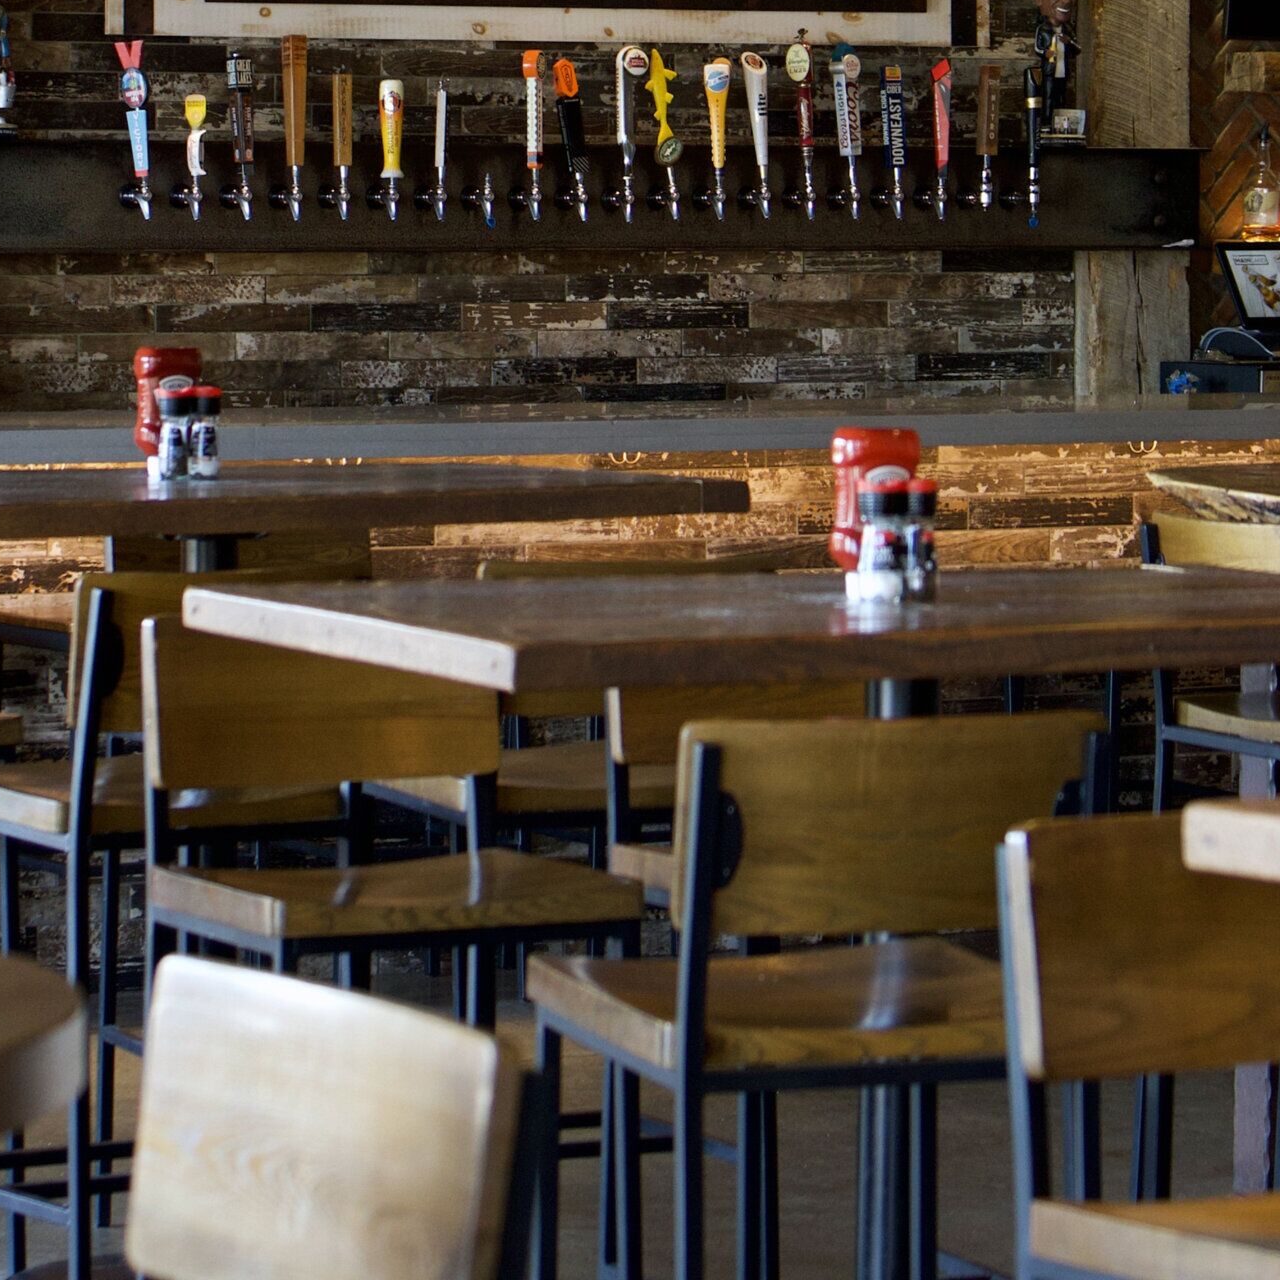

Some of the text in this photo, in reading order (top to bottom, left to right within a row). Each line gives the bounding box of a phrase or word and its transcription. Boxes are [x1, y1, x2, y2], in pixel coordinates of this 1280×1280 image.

[836, 88, 846, 116] LIGHT
[989, 94, 997, 141] NITRO
[132, 111, 145, 168] VICTORY
[888, 98, 905, 166] DOWNEAST
